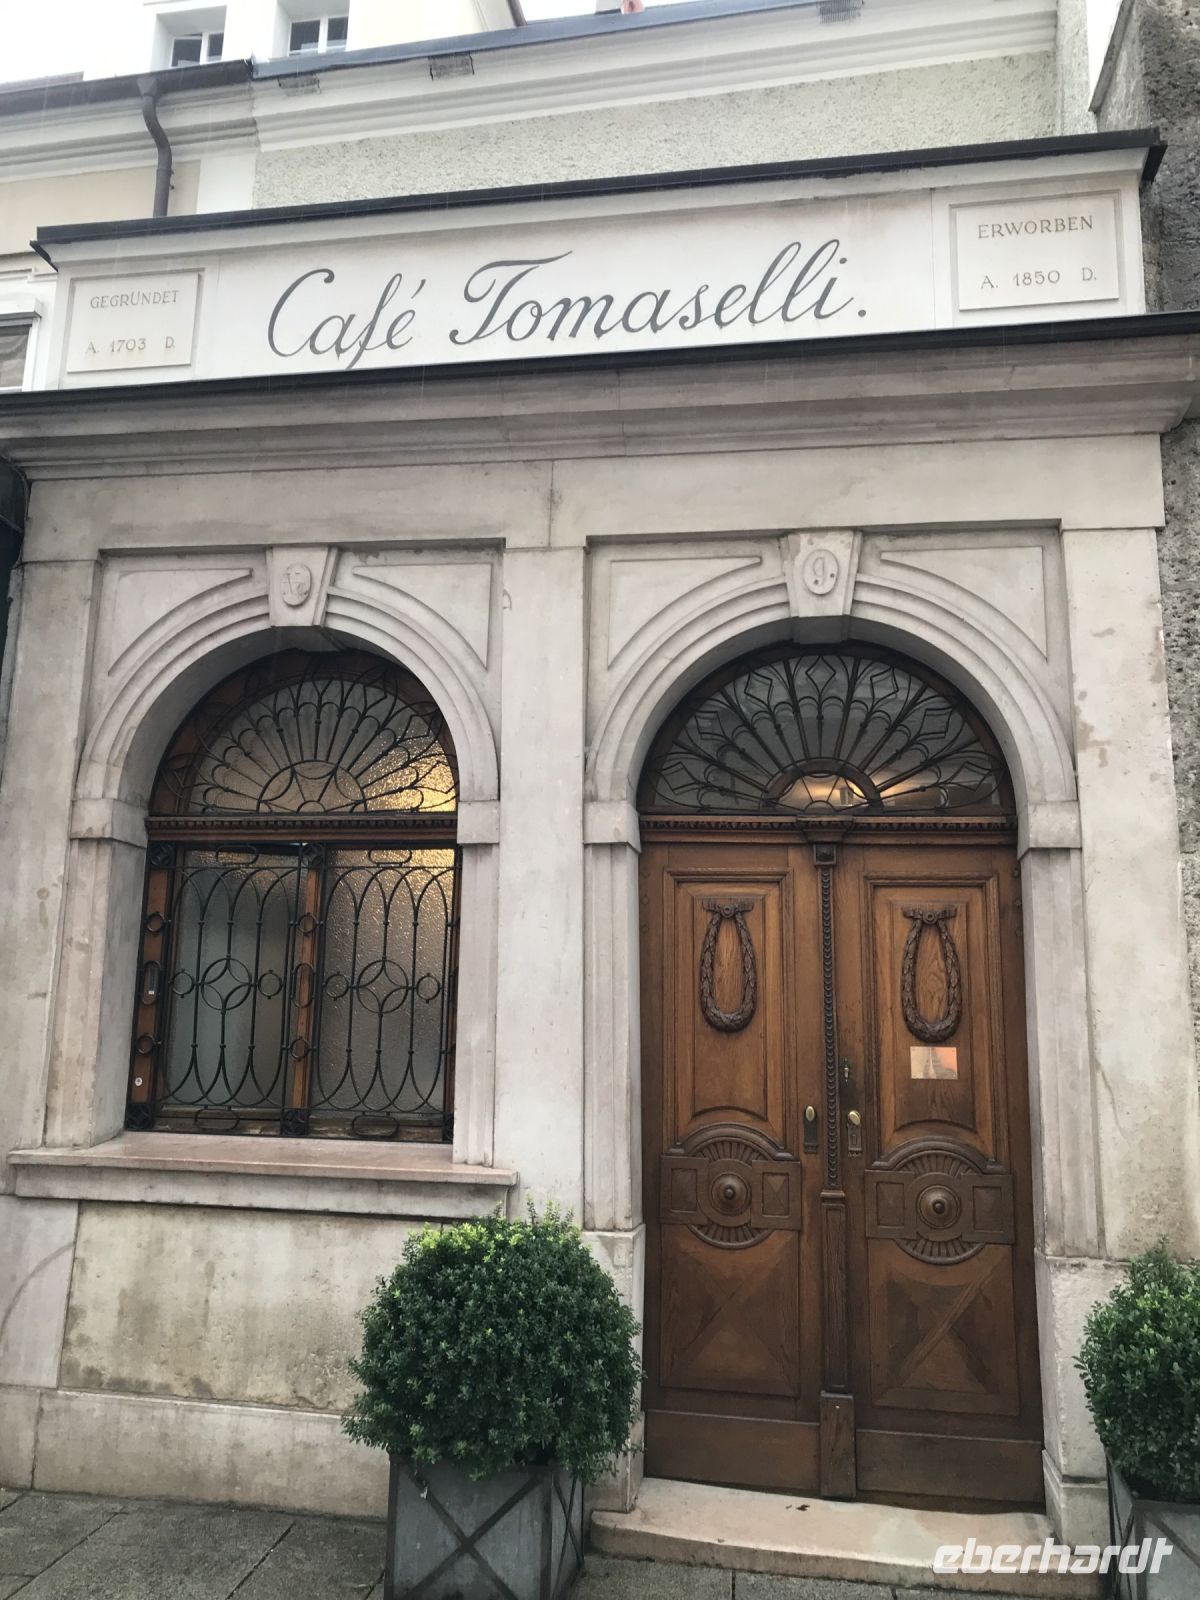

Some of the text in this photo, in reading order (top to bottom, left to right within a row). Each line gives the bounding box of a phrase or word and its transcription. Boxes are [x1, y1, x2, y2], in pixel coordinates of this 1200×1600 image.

[978, 215, 1093, 239] ERWORBEN
[980, 266, 1097, 289] A. 1850 D.
[267, 238, 867, 370] Café Tomaselli.
[110, 337, 146, 353] 1703
